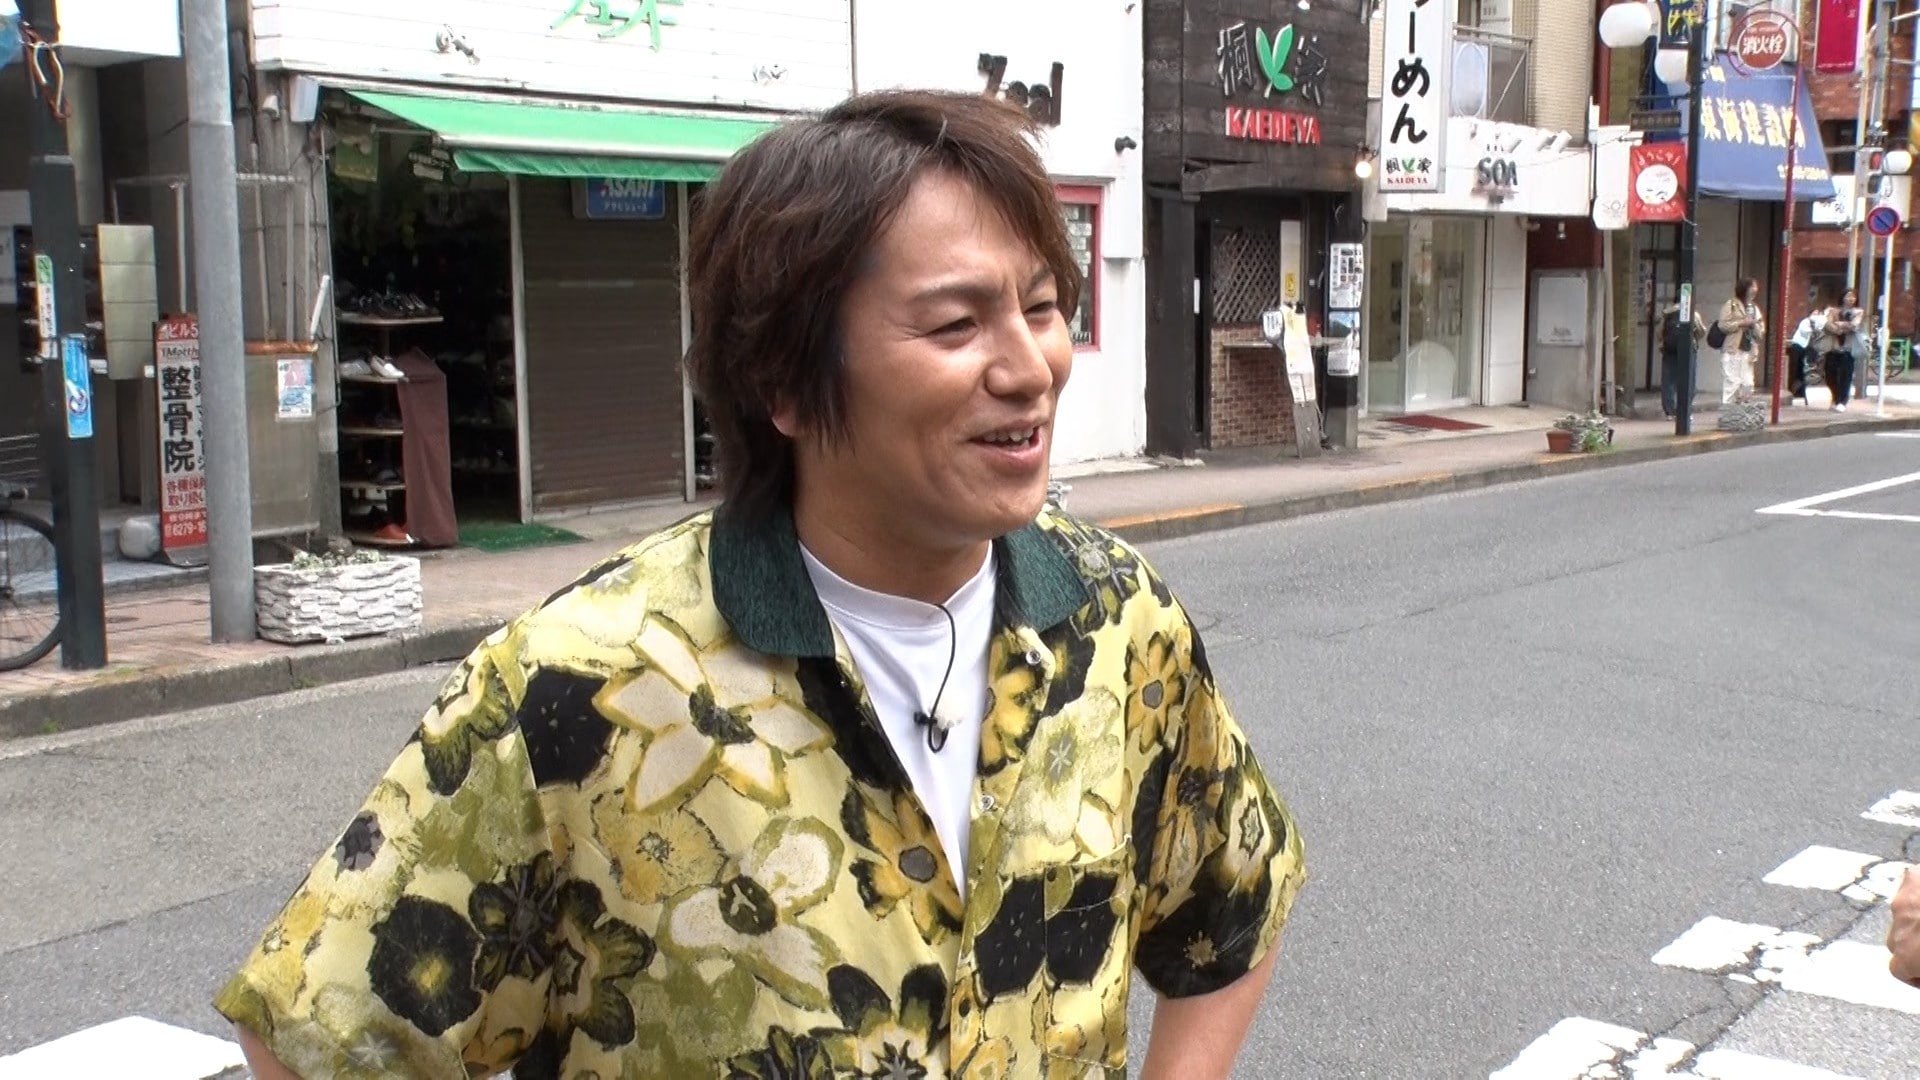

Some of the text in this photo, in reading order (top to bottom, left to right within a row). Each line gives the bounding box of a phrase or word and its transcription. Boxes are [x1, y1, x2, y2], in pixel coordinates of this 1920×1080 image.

[1742, 34, 1784, 56] 消火栓
[1391, 0, 1429, 144] ーめん
[1225, 106, 1323, 146] KAEDEYA
[600, 178, 656, 198] ASAHI
[161, 365, 196, 474] 整骨院
